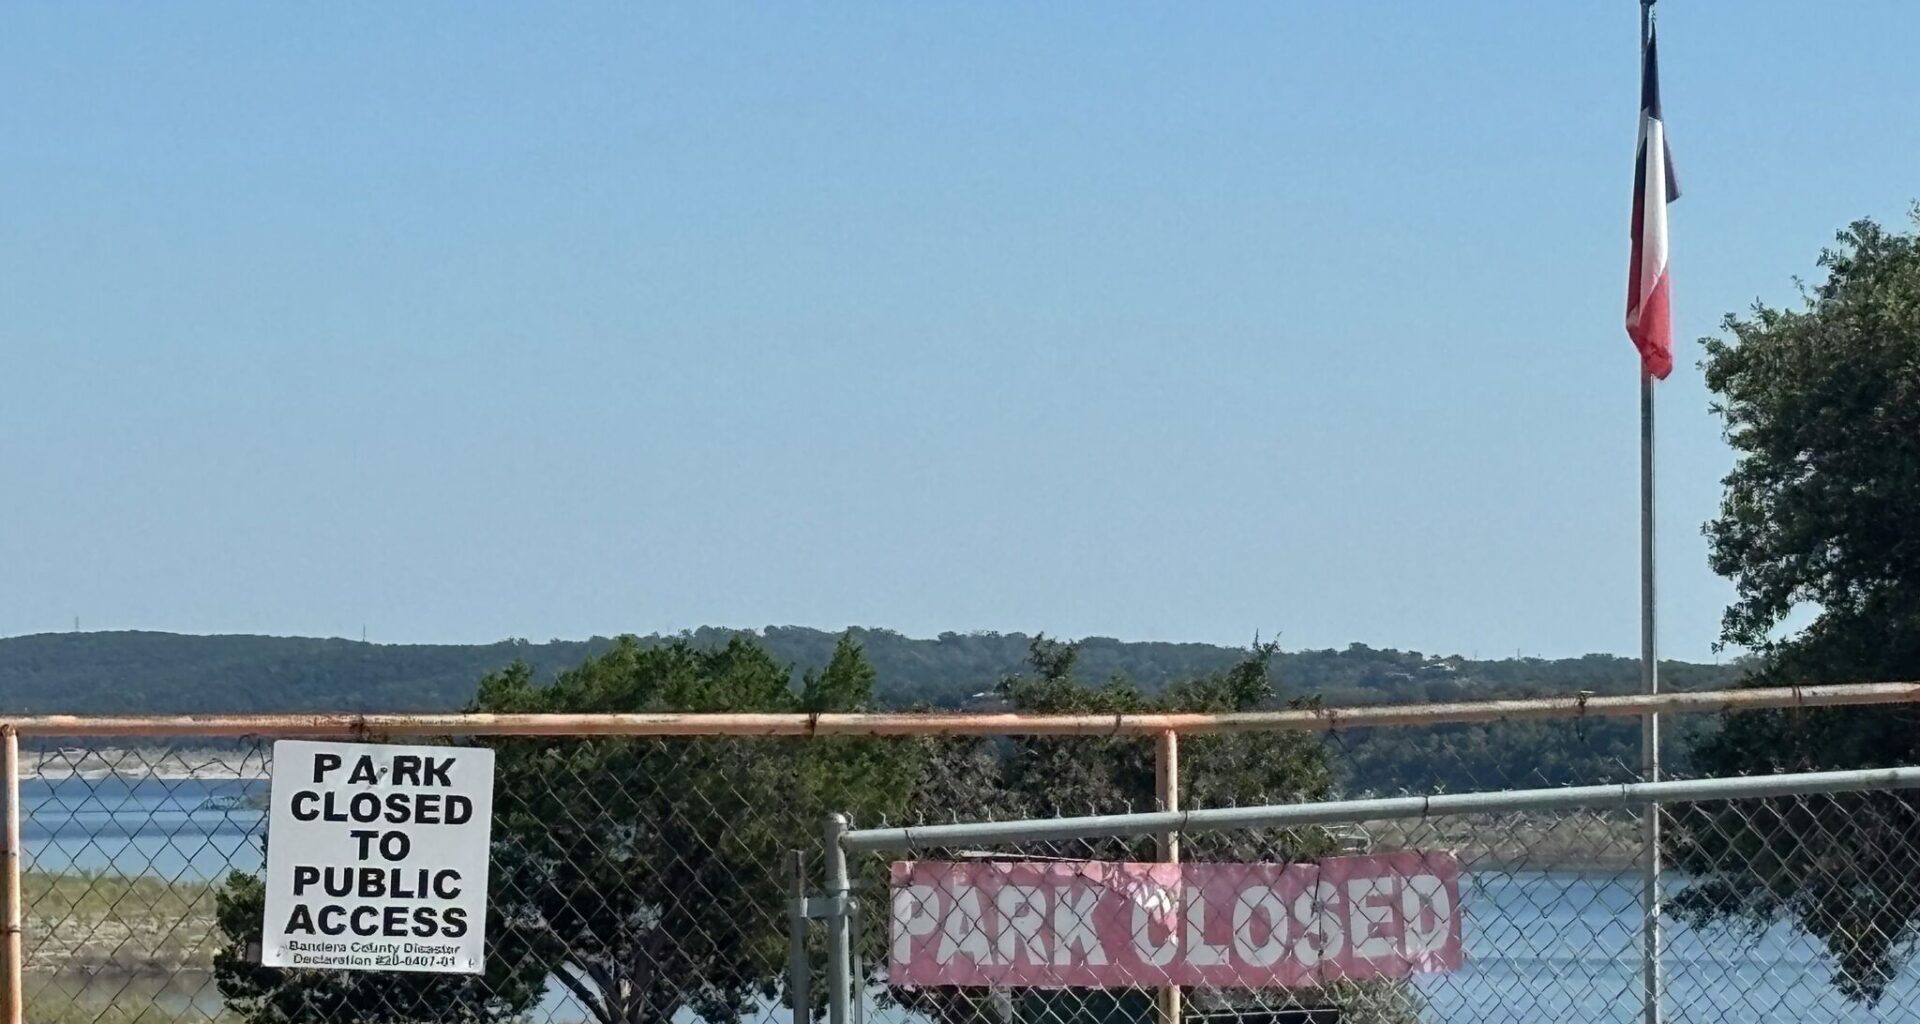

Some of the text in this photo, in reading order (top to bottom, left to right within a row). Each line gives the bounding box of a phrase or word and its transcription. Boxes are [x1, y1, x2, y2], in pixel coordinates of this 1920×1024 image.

[313, 753, 456, 787] PARK
[291, 790, 473, 825] CLOSED
[350, 830, 411, 861] TO
[293, 865, 462, 900] PUBLIC
[284, 904, 468, 938] ACCESS
[893, 874, 1451, 967] PARK CLOSED
[288, 940, 460, 956] Bandera County Disaster
[293, 953, 372, 966] Declaration
